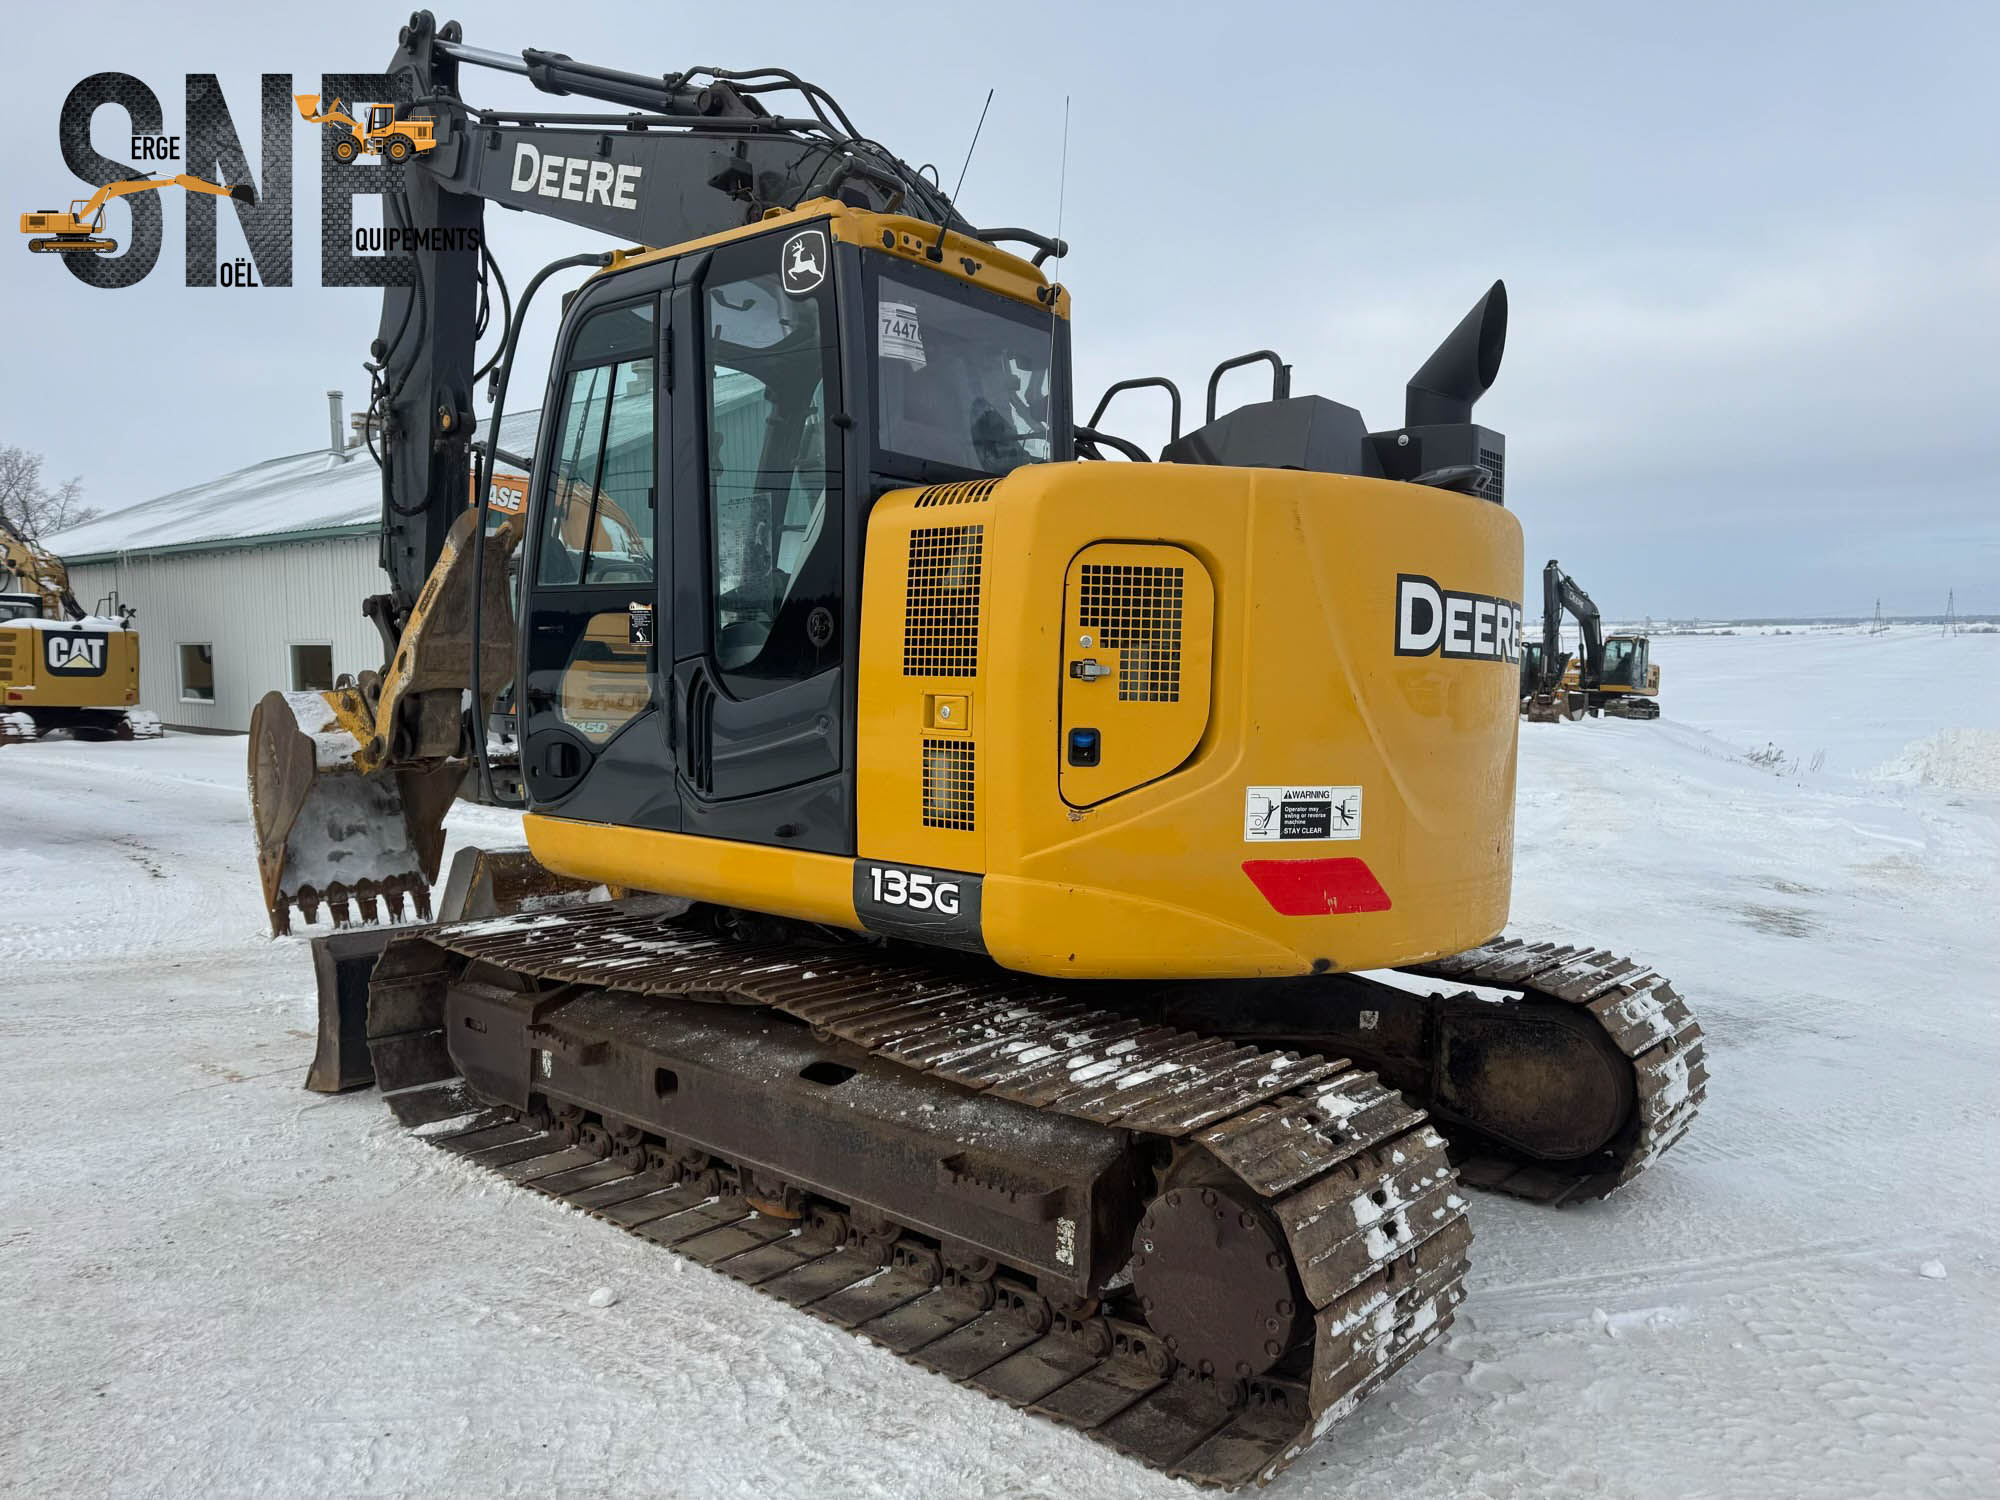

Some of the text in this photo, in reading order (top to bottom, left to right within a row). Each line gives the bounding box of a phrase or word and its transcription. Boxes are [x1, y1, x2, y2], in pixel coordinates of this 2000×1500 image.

[511, 142, 642, 210] DEERE
[882, 319, 922, 341] 7447
[1396, 576, 1521, 662] DEERE
[48, 636, 105, 669] CAT
[1292, 790, 1330, 799] WARNING
[1301, 826, 1322, 834] CLEAR
[871, 867, 959, 914] 135G
